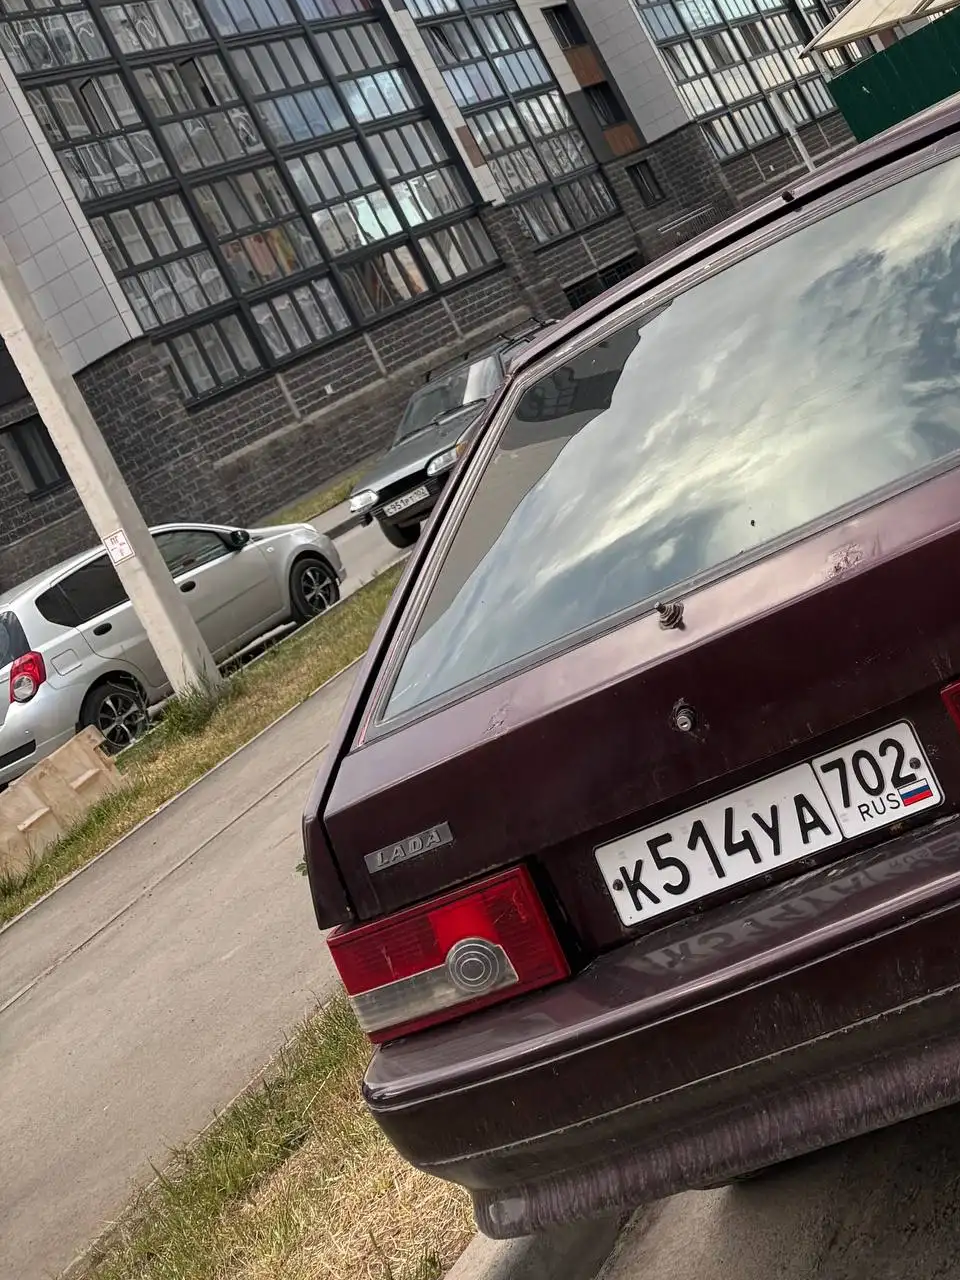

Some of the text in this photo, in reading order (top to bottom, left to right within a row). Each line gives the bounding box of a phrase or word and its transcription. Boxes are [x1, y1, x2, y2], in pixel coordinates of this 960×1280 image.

[619, 738, 917, 911] К514УА 702
[858, 792, 901, 822] RUS
[376, 829, 441, 867] LADA
